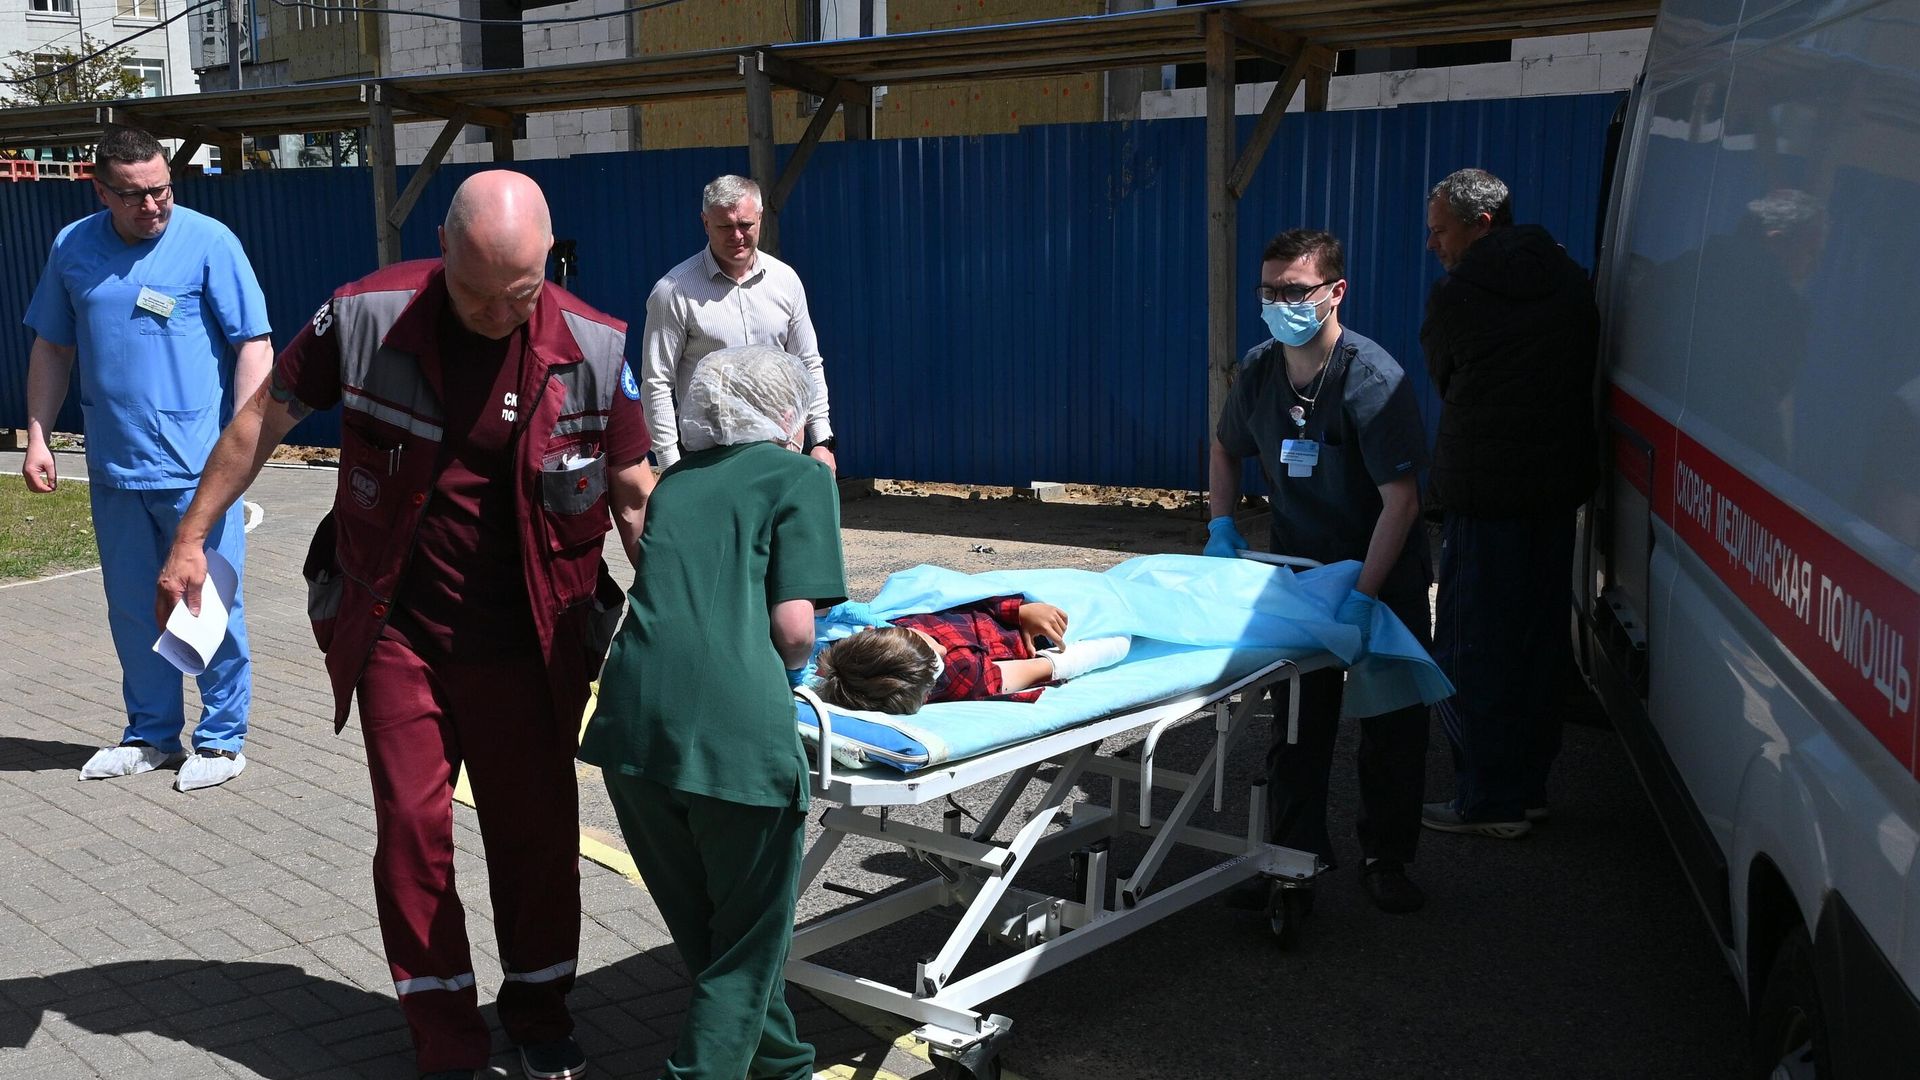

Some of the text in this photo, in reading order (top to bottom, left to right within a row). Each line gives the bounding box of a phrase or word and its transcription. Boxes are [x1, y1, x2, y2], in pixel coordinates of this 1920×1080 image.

[1676, 460, 1911, 717] СКОРАЯ МЕДИЦИНСКАЯ ПОМОЩЬ
